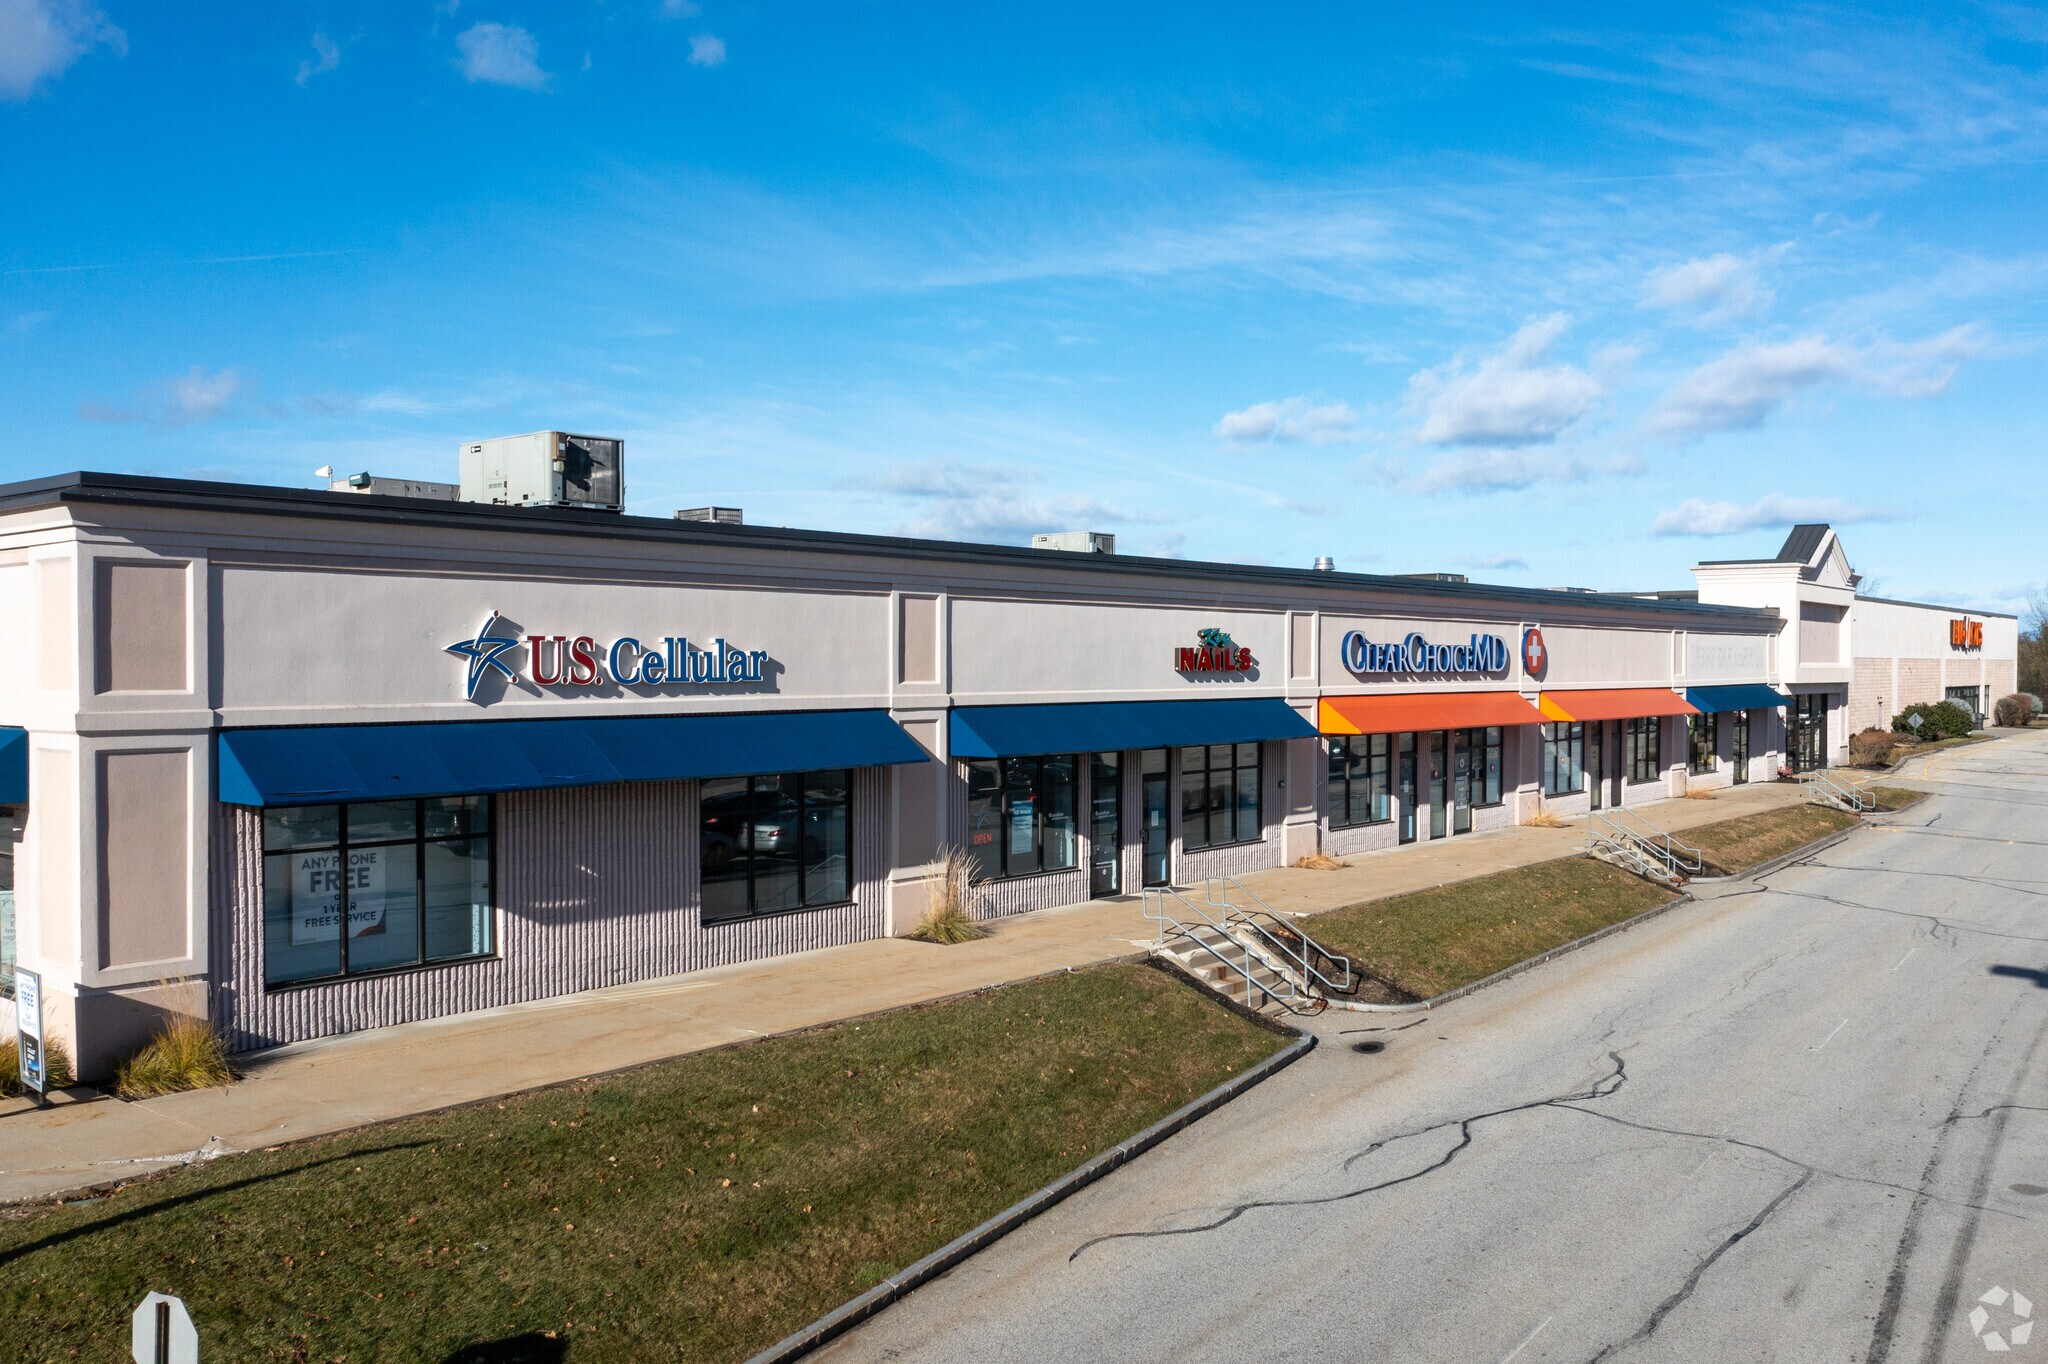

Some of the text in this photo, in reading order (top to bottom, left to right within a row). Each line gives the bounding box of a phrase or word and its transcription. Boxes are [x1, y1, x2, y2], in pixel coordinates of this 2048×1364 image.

[525, 635, 768, 685] U.S. Cellular
[1178, 647, 1252, 671] NAILS
[973, 832, 992, 846] OPEN
[302, 853, 377, 870] ANY PONE
[330, 902, 357, 914] YER
[305, 911, 377, 928] FREE SRVICE
